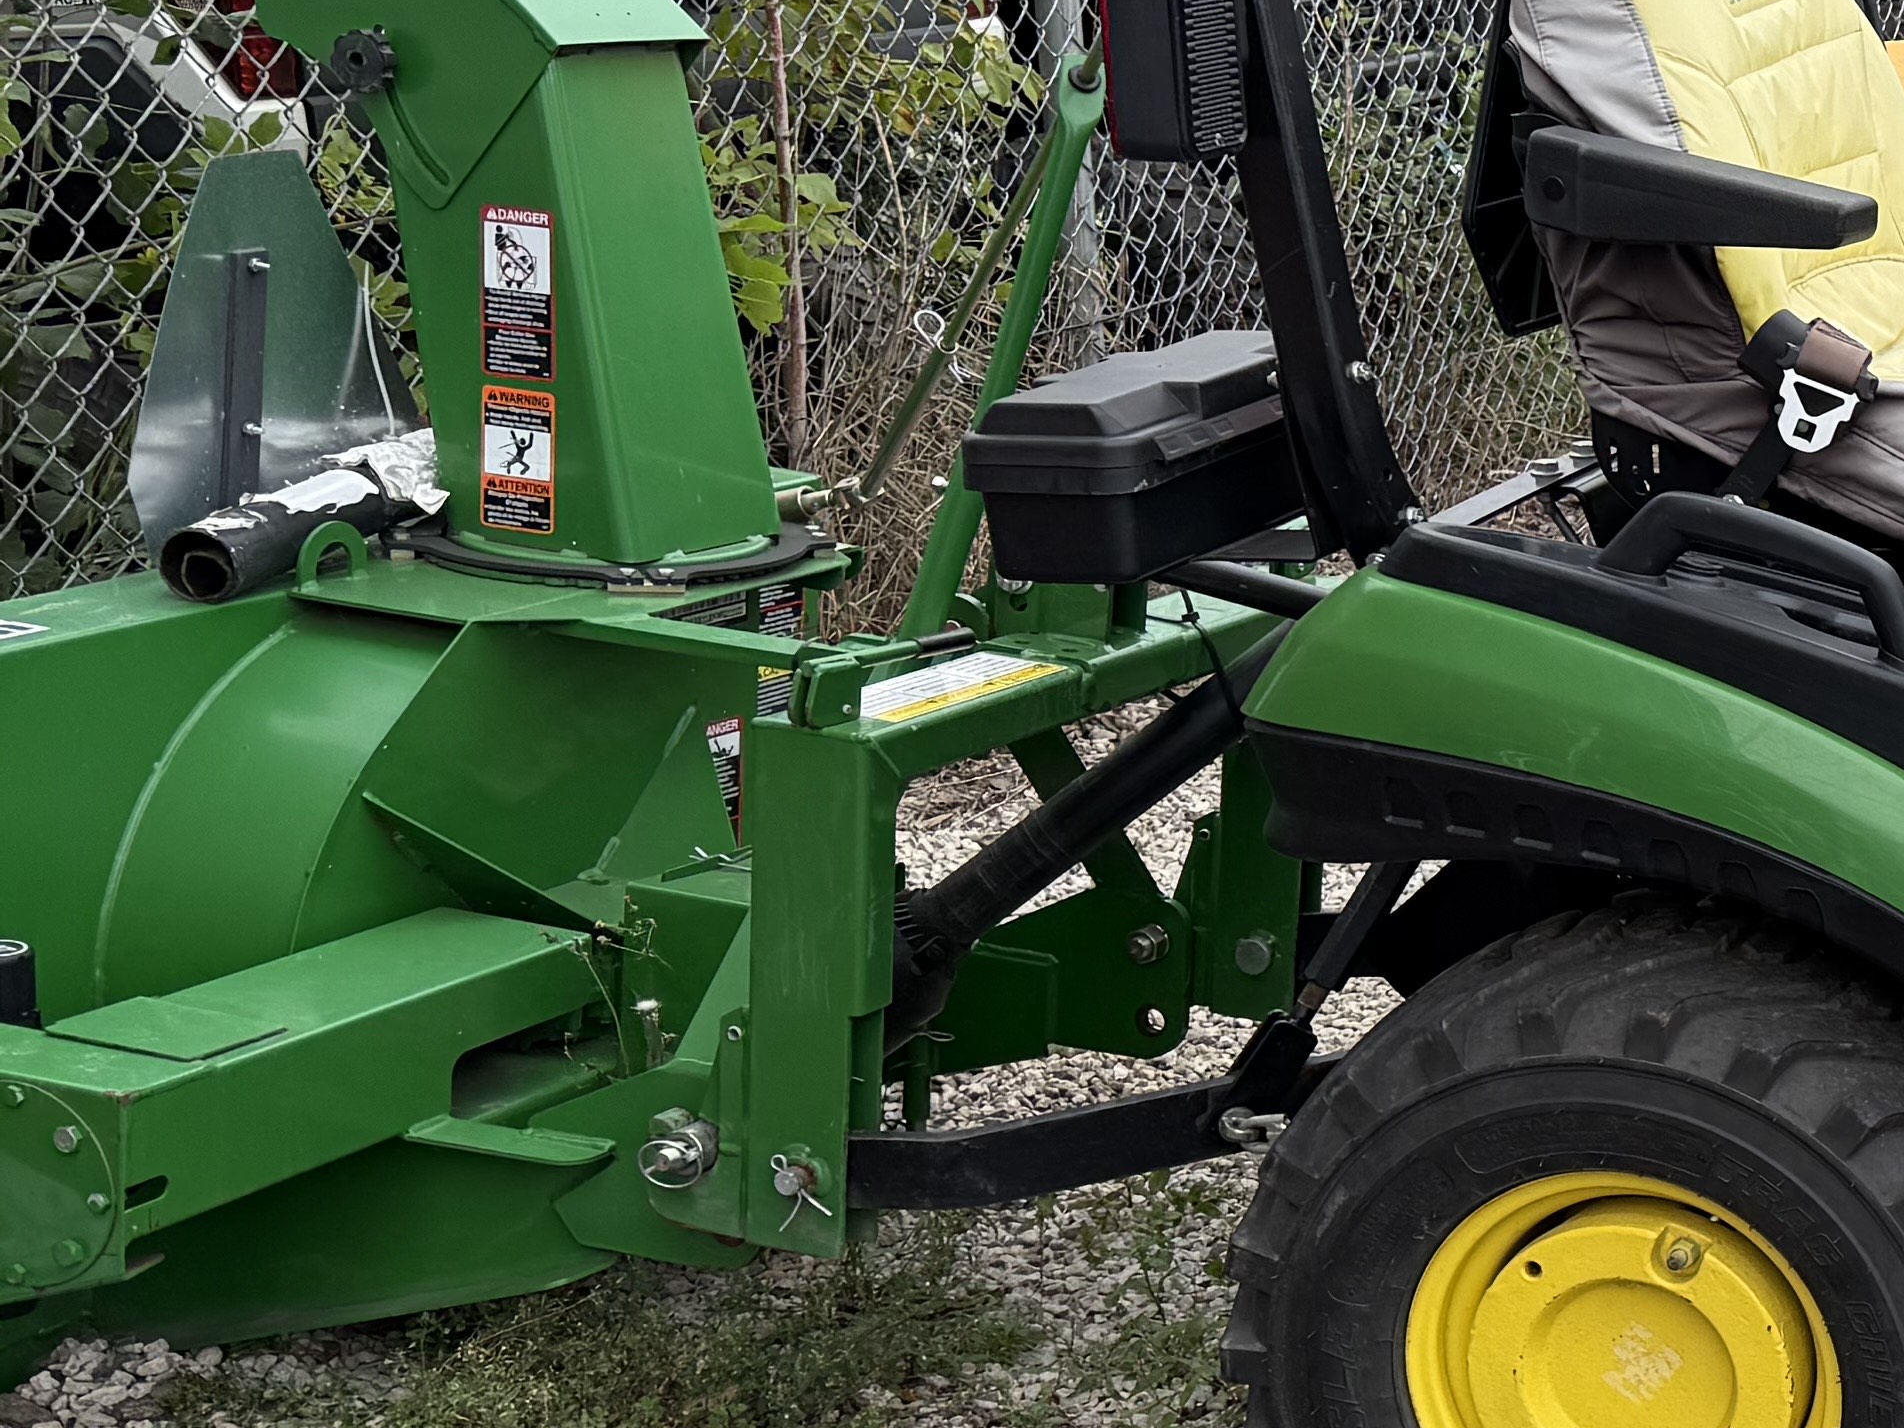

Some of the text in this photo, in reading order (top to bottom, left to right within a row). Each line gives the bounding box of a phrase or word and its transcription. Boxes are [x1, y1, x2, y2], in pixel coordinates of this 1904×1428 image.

[497, 208, 549, 225] DANGER
[498, 390, 550, 408] WARNING
[497, 478, 550, 496] ATTENTION
[706, 719, 739, 737] ANGER
